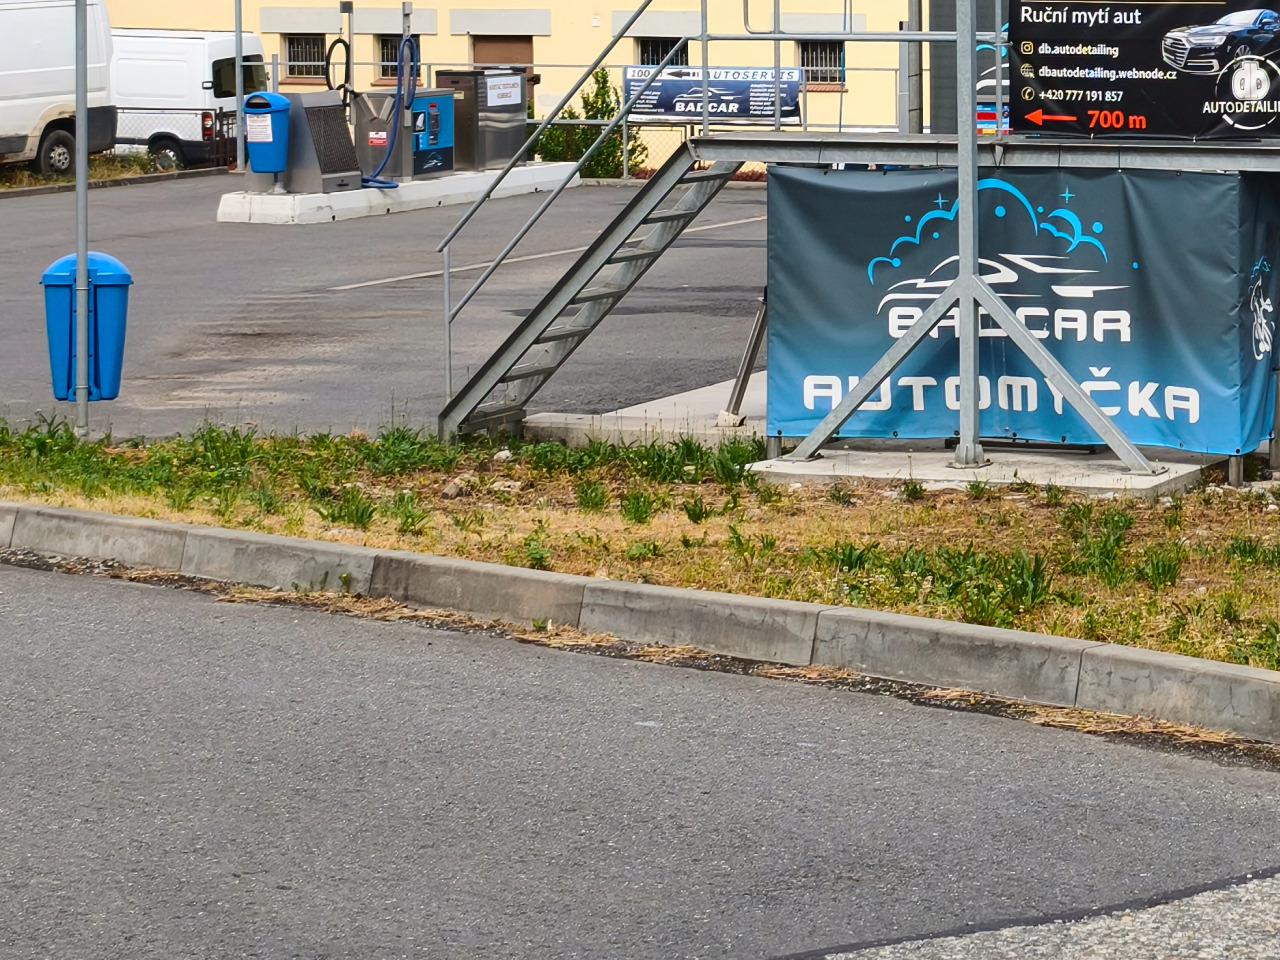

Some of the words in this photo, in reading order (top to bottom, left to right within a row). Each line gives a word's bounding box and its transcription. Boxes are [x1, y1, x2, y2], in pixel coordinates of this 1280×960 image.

[1020, 6, 1069, 24] Ruční
[1072, 7, 1111, 27] mytí
[1114, 8, 1142, 25] aut
[1038, 43, 1119, 58] db.autodetailing
[631, 69, 651, 78] 100
[1038, 66, 1178, 82] dbautodetailing.webnode.cz
[1038, 89, 1064, 101] +420
[1066, 90, 1083, 101] 777
[1086, 90, 1103, 102] 191
[1105, 90, 1124, 102] 857
[1087, 110, 1125, 129] 700
[1128, 114, 1147, 129] m
[803, 366, 1201, 424] AUTOMYČKA
